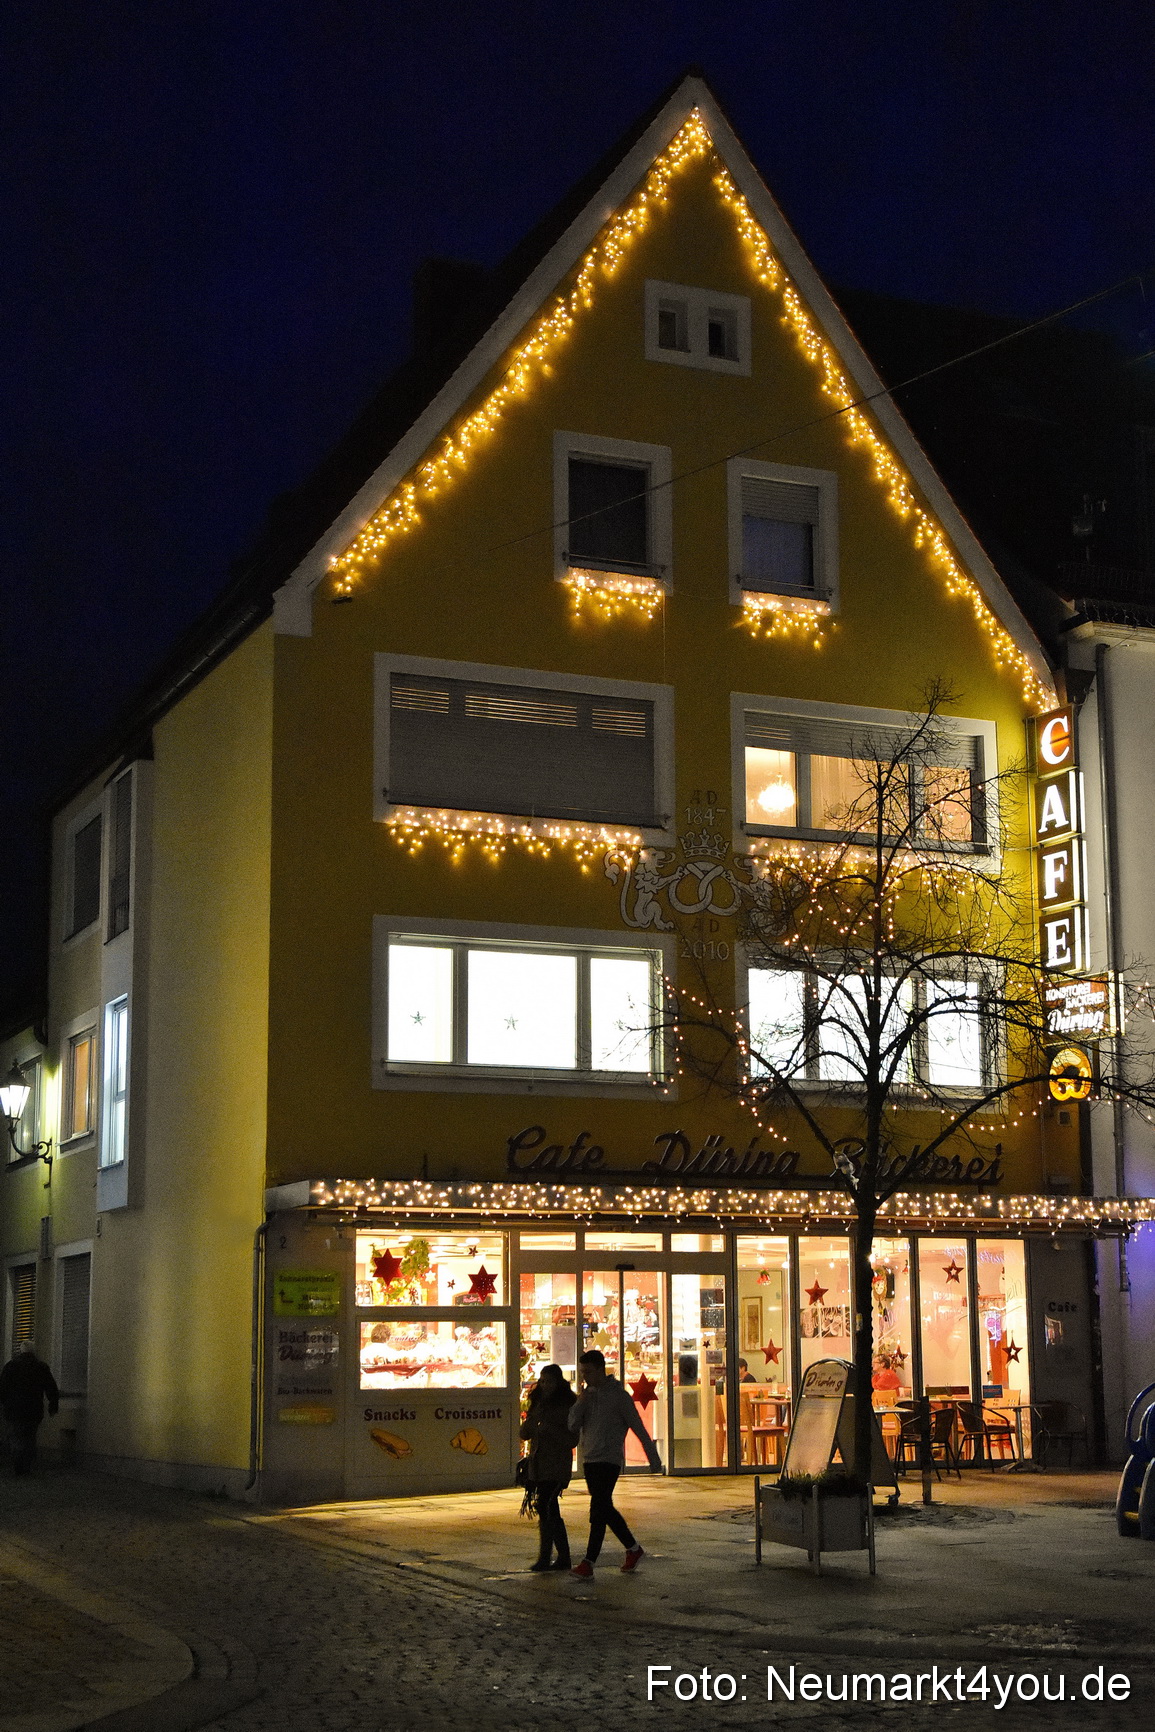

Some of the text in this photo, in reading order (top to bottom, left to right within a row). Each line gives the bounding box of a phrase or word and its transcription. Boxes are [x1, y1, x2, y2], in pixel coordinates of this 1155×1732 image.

[684, 807, 727, 827] 1847
[1037, 716, 1071, 968] CAFE
[680, 938, 730, 961] 2010
[507, 1125, 608, 1173] Cafe
[642, 1129, 801, 1181] Düring
[363, 1407, 502, 1421] Snacks Croissant
